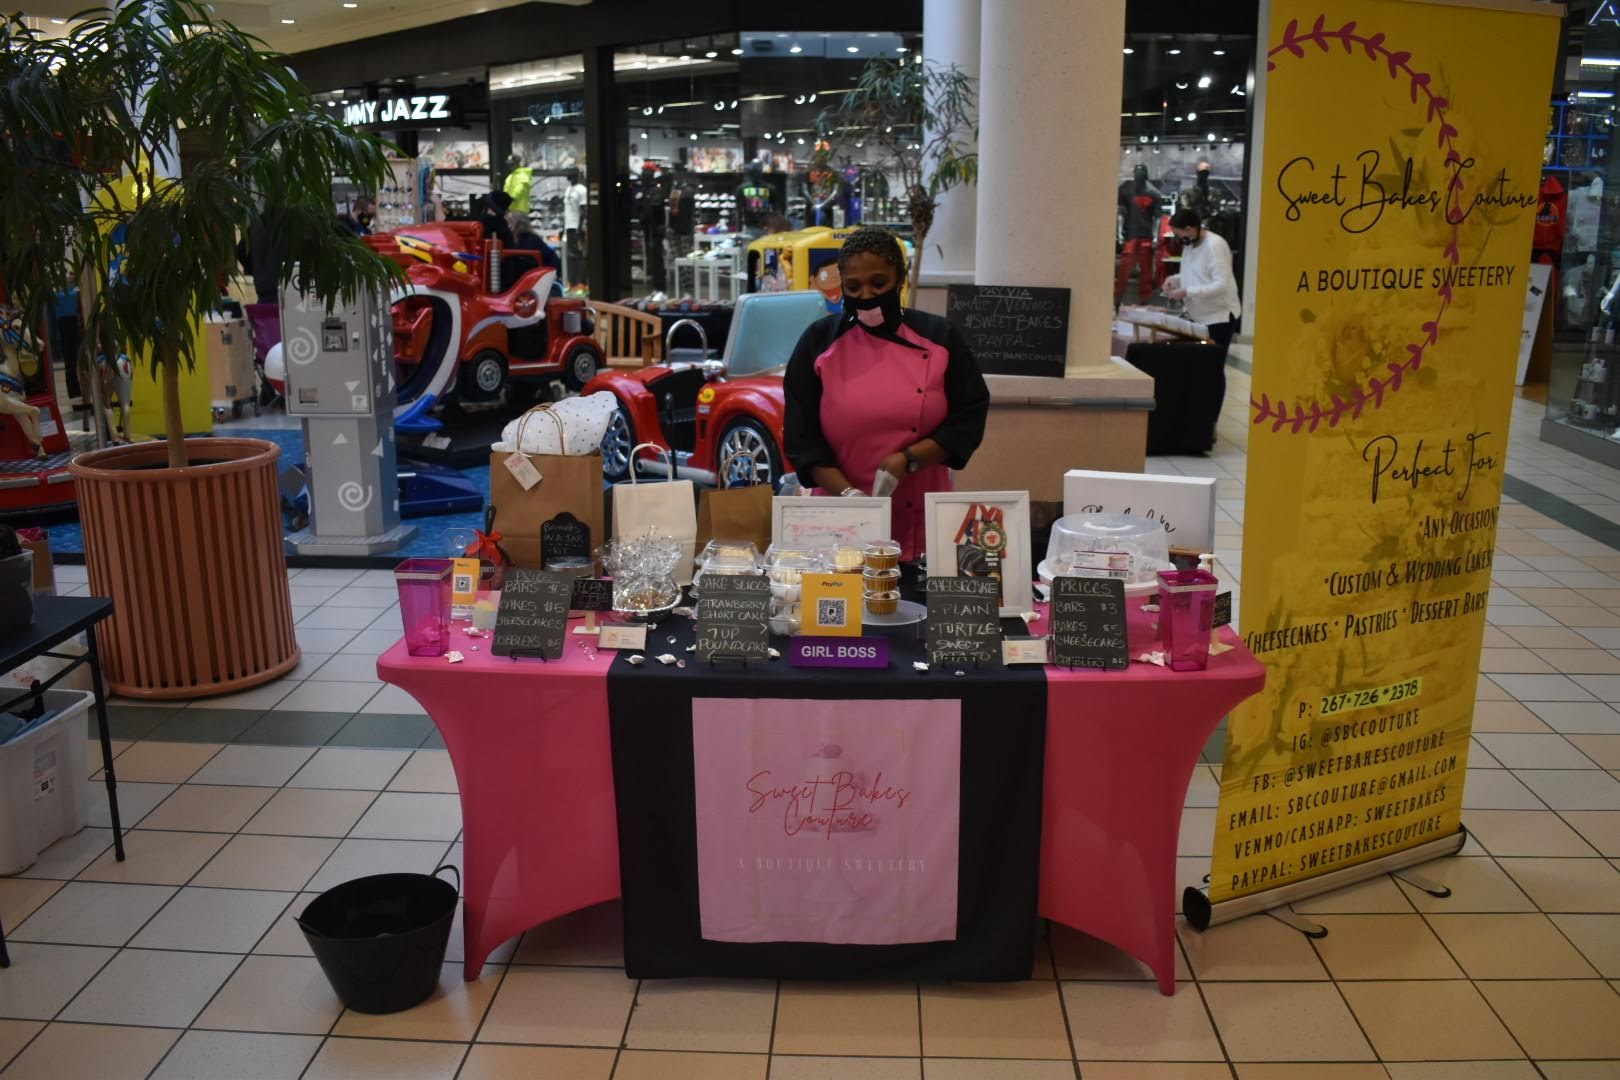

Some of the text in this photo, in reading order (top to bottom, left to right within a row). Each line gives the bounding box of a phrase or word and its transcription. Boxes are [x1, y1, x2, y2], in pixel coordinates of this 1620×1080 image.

[380, 95, 450, 122] JAZZ
[1277, 150, 1540, 233] Sweet Bakes Couture
[979, 286, 1031, 297] PAY VIA
[1296, 265, 1515, 293] A BOUTIQUE SWEETERY
[1363, 435, 1456, 504] Perfect
[1386, 562, 1400, 585] &
[1406, 556, 1461, 584] WEDDING
[504, 580, 540, 593] BARS
[1060, 579, 1112, 595] PRICES
[699, 599, 767, 611] STRAWBERRY
[938, 602, 990, 616] PLAIN
[1055, 600, 1087, 613] BARS
[1344, 609, 1398, 639] PASTRIES
[1410, 598, 1460, 625] DESSERT
[707, 627, 740, 640] 7 UP
[934, 622, 996, 637] TURTLE
[801, 645, 877, 659] GIRL BOSS
[1298, 701, 1313, 719] P:
[1292, 708, 1420, 752] IG: @SBCCOUTURE
[1253, 731, 1446, 793] FB: @SWEETBAKESCOUTURE
[746, 770, 911, 813] Sweet Bakes
[1229, 755, 1457, 831] EMAIL: SBCCOUTURE@GMAIL.COM
[784, 797, 873, 840] Couture
[1234, 786, 1447, 860] VENMO/CASHAPP: SWEETBAKES
[1231, 816, 1441, 891] PAYPAL: SWEETBAKESCOUTURE
